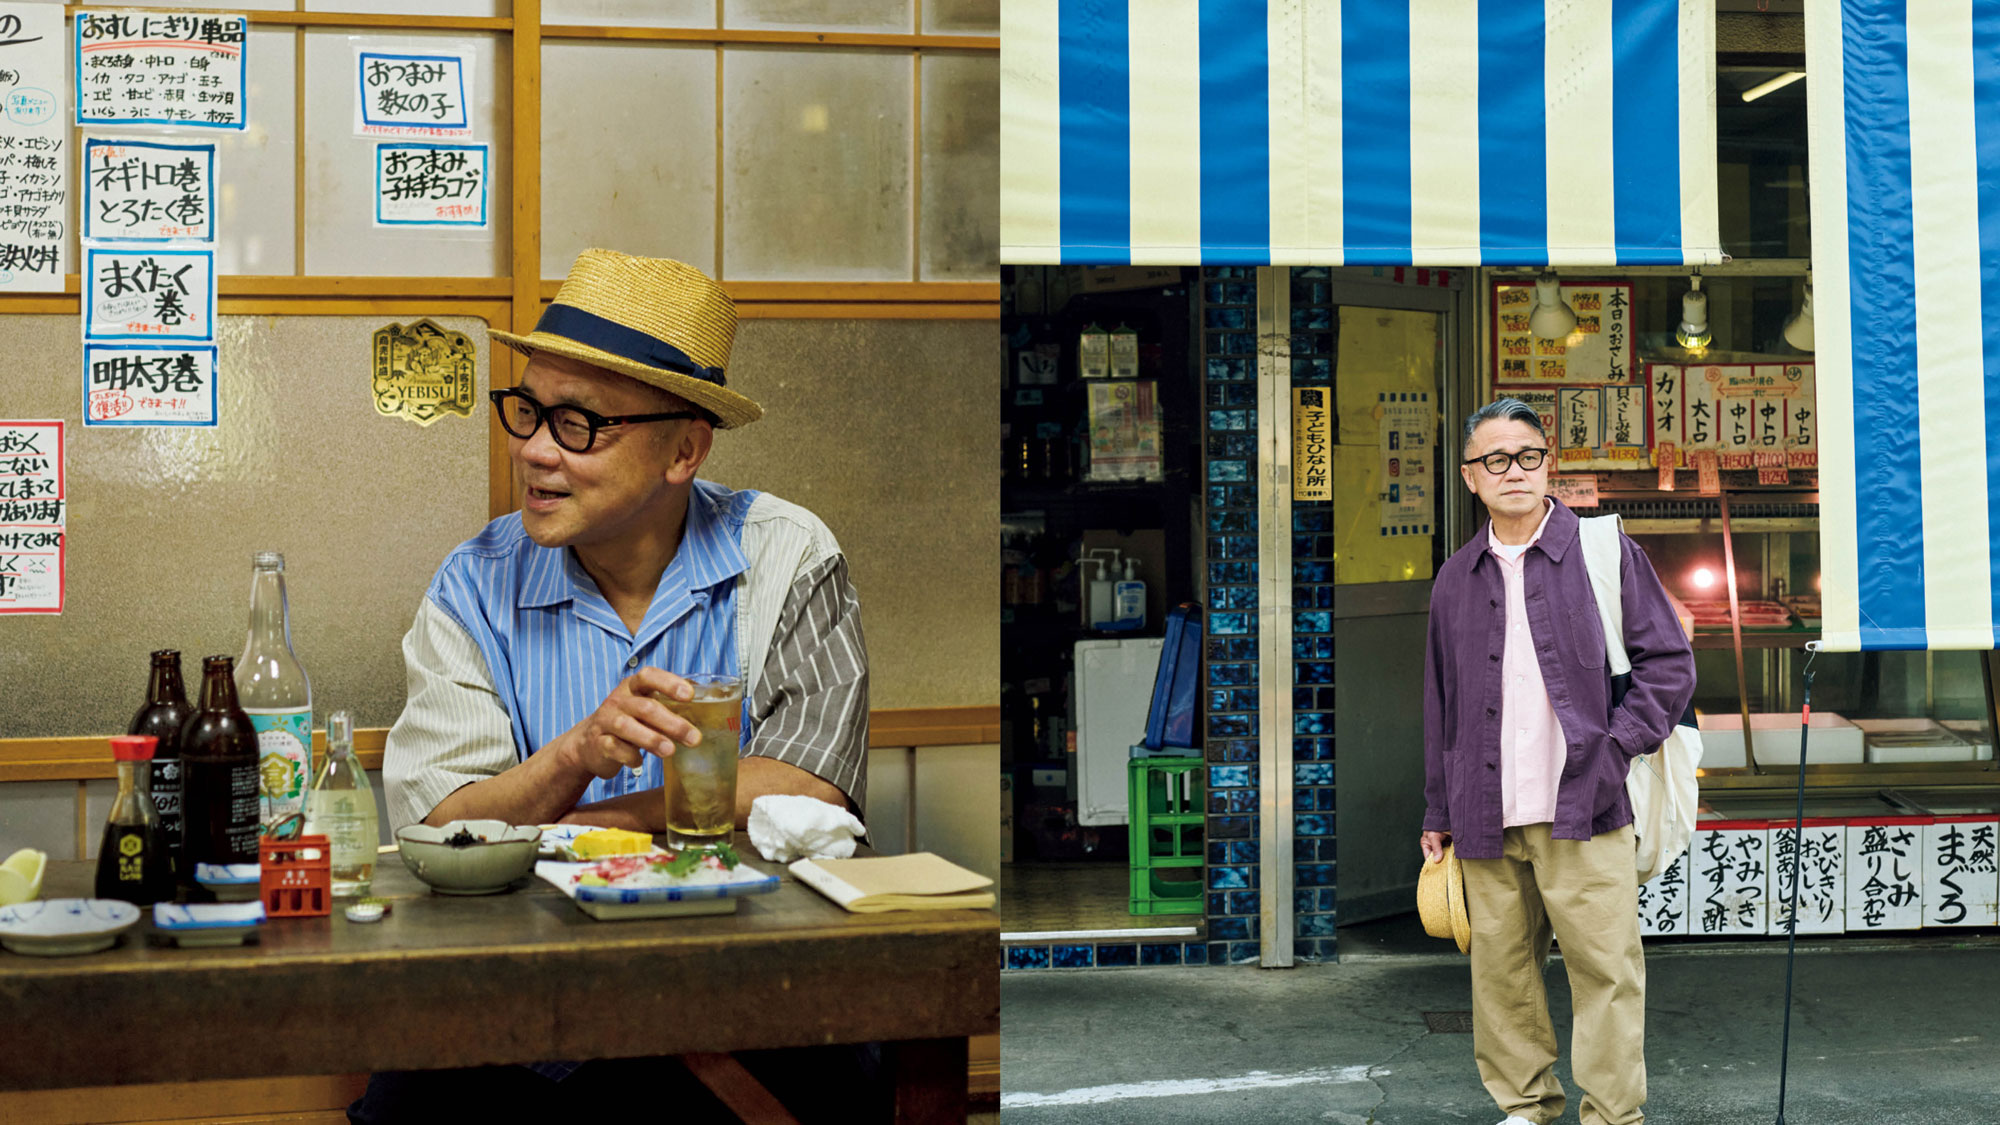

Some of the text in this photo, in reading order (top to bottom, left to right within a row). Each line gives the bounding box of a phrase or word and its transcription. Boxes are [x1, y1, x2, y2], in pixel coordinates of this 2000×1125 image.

[82, 14, 245, 44] おすしにぎり単品
[367, 60, 447, 87] おつまみ
[378, 87, 455, 120] 数の子
[91, 155, 201, 192] ネギトロ巻
[385, 149, 468, 176] おつまみ
[382, 169, 480, 201] 子持ちコブ
[100, 194, 204, 227] とろたく巻
[99, 257, 193, 298] まぐたく
[153, 289, 187, 325] 巻
[1607, 287, 1629, 382] 本日のおさしみ
[93, 353, 204, 393] 明太子巻
[397, 386, 451, 399] YEBISU
[1656, 371, 1675, 432] カツオ
[1691, 398, 1711, 443] 大トロ
[1730, 402, 1747, 445] 中トロ
[1760, 401, 1776, 446] 中トロ
[1794, 407, 1811, 445] 中トロ
[1305, 411, 1327, 487] 子どもひなん所
[0, 532, 64, 549] けてみて
[1887, 828, 1920, 907] さしみ
[1969, 825, 1997, 873] 天然
[1656, 850, 1688, 933] 屋さんの
[1701, 830, 1737, 933] もずく酢
[1735, 834, 1765, 928] やみつき
[1818, 832, 1842, 923] とびきり
[1859, 826, 1891, 927] 盛り合わせ
[1934, 824, 1971, 924] まぐろ
